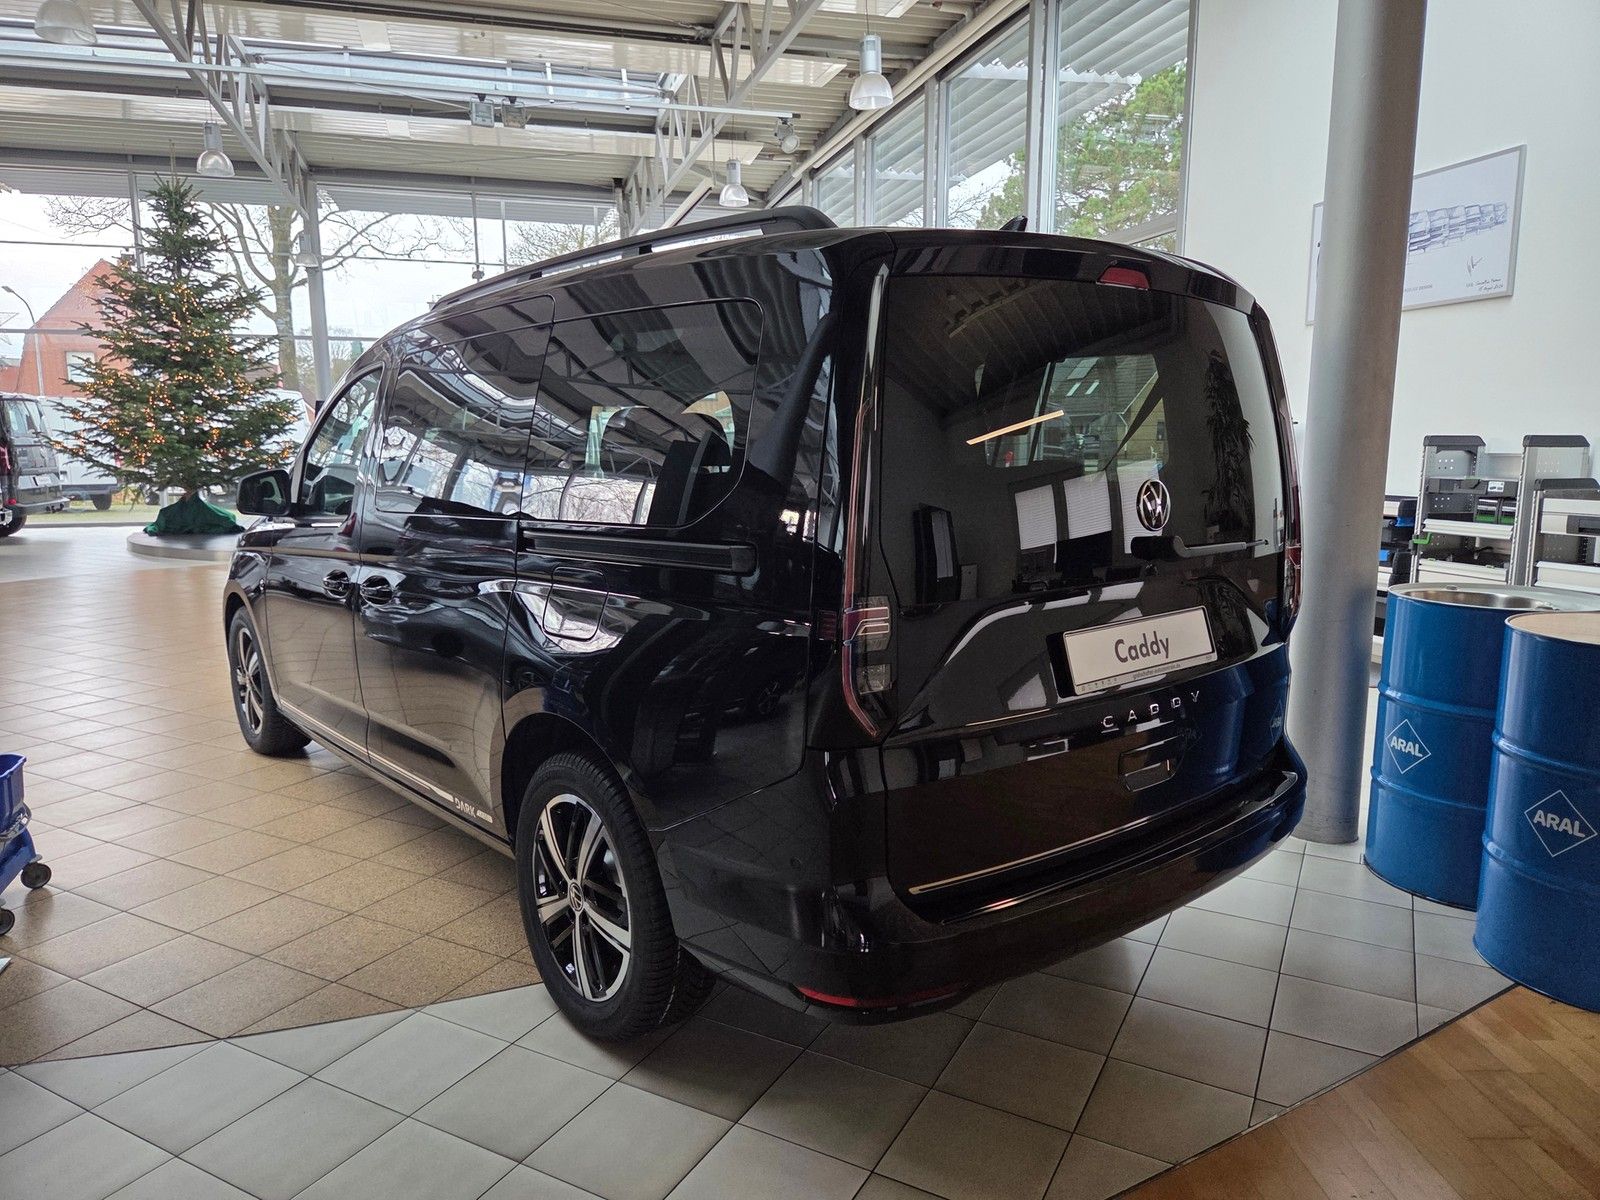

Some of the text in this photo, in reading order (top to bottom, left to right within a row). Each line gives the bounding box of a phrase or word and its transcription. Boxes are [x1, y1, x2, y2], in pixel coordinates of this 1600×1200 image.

[1114, 631, 1170, 663] Caddy
[1102, 690, 1200, 728] CADDY
[1390, 735, 1424, 758] ARAL
[454, 797, 476, 818] DARK
[1532, 809, 1586, 838] ARAL
